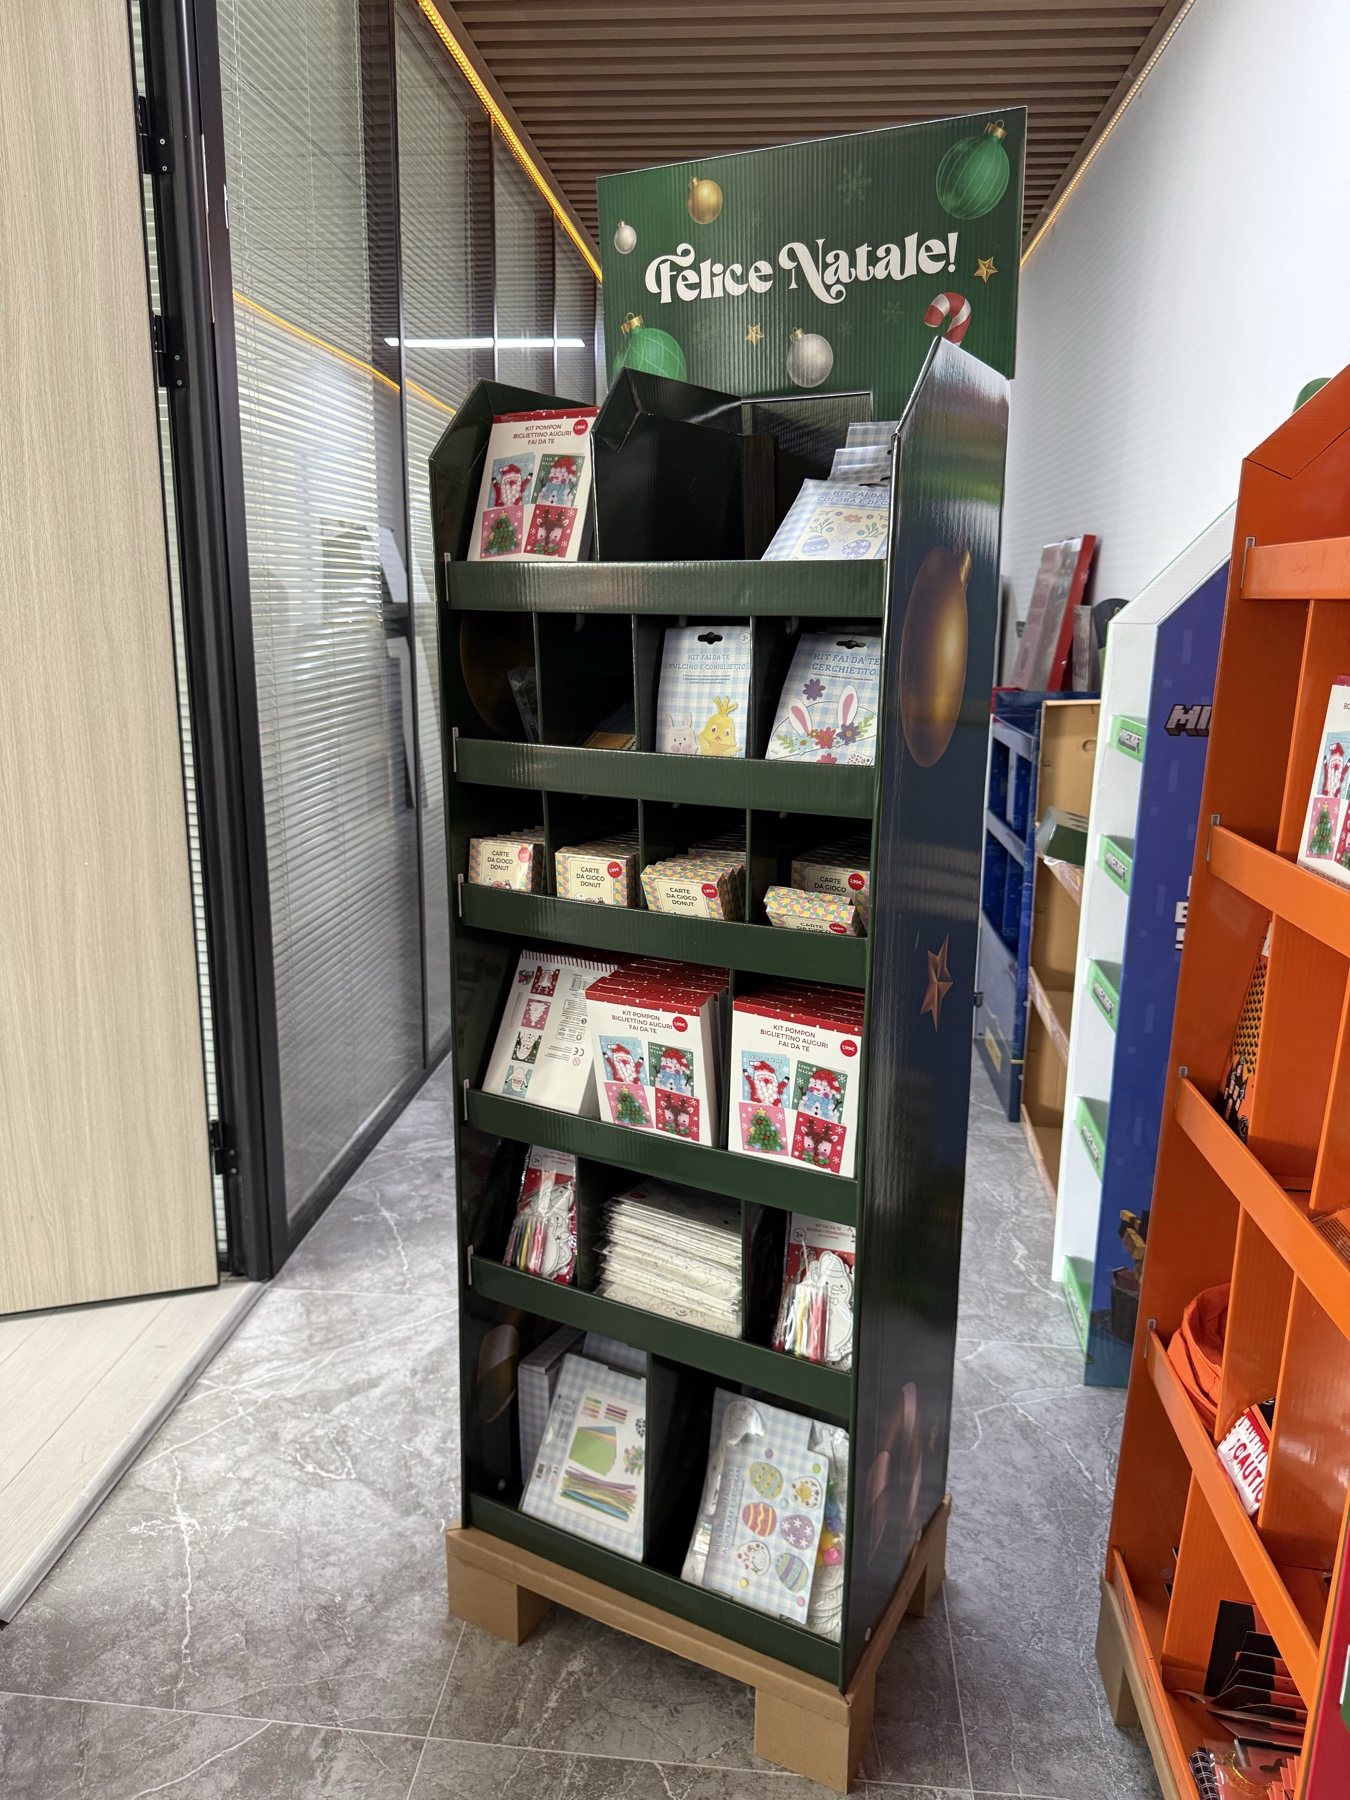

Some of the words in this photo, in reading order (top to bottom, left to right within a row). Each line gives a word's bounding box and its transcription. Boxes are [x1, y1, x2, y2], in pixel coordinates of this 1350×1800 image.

[645, 243, 773, 303] Felice
[778, 232, 959, 304] Natale!
[813, 653, 831, 661] KIT
[832, 655, 849, 663] FAI
[850, 656, 865, 665] DA
[867, 657, 880, 666] TE
[811, 662, 876, 676] CERCHIETTO
[496, 857, 513, 865] GIOCO
[580, 866, 600, 874] CARTE
[586, 874, 605, 882] GIOCO
[820, 877, 841, 885] CARTE
[580, 880, 601, 888] DONUT
[670, 887, 691, 895] CARTE
[825, 884, 846, 893] GIOCO
[676, 894, 697, 902] GIOCO
[633, 1012, 660, 1021] POMPON
[612, 1015, 648, 1026] BIGLIETTINO
[649, 1022, 673, 1030] AUGURI
[773, 1024, 784, 1032] KIT
[785, 1026, 815, 1038] POMPON
[760, 1028, 800, 1042] BIGLIETTINO
[801, 1037, 828, 1049] AUGURI
[778, 1040, 790, 1048] FAI
